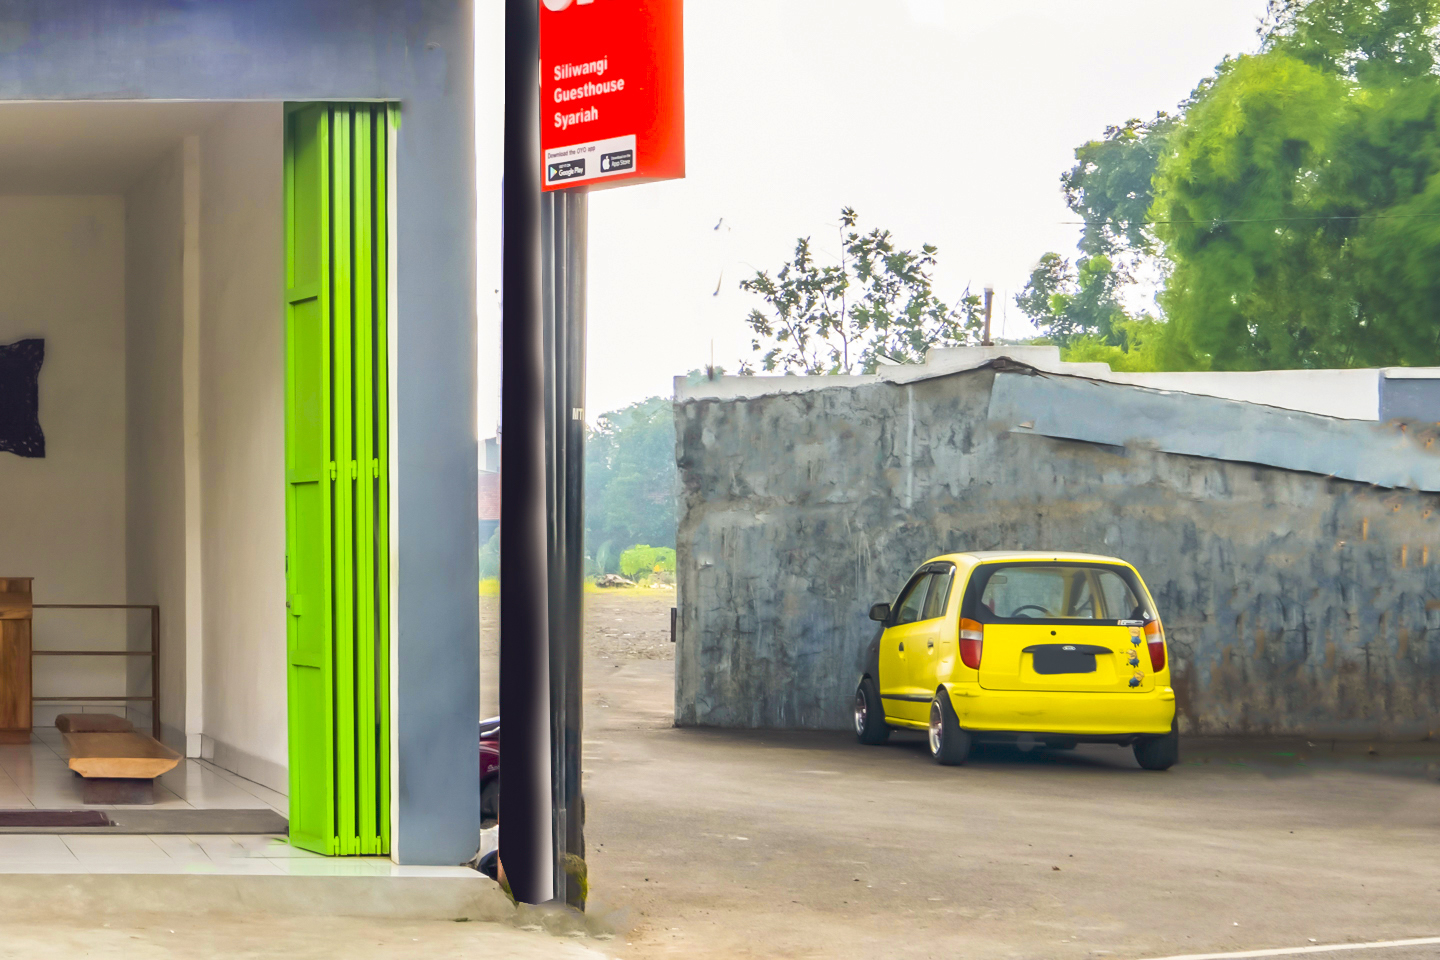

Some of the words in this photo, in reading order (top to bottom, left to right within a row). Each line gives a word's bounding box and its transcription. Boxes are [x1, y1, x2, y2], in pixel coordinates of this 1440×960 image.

[554, 55, 608, 81] Siliwangi
[554, 78, 625, 103] Guesthouse
[554, 105, 599, 131] Syariah
